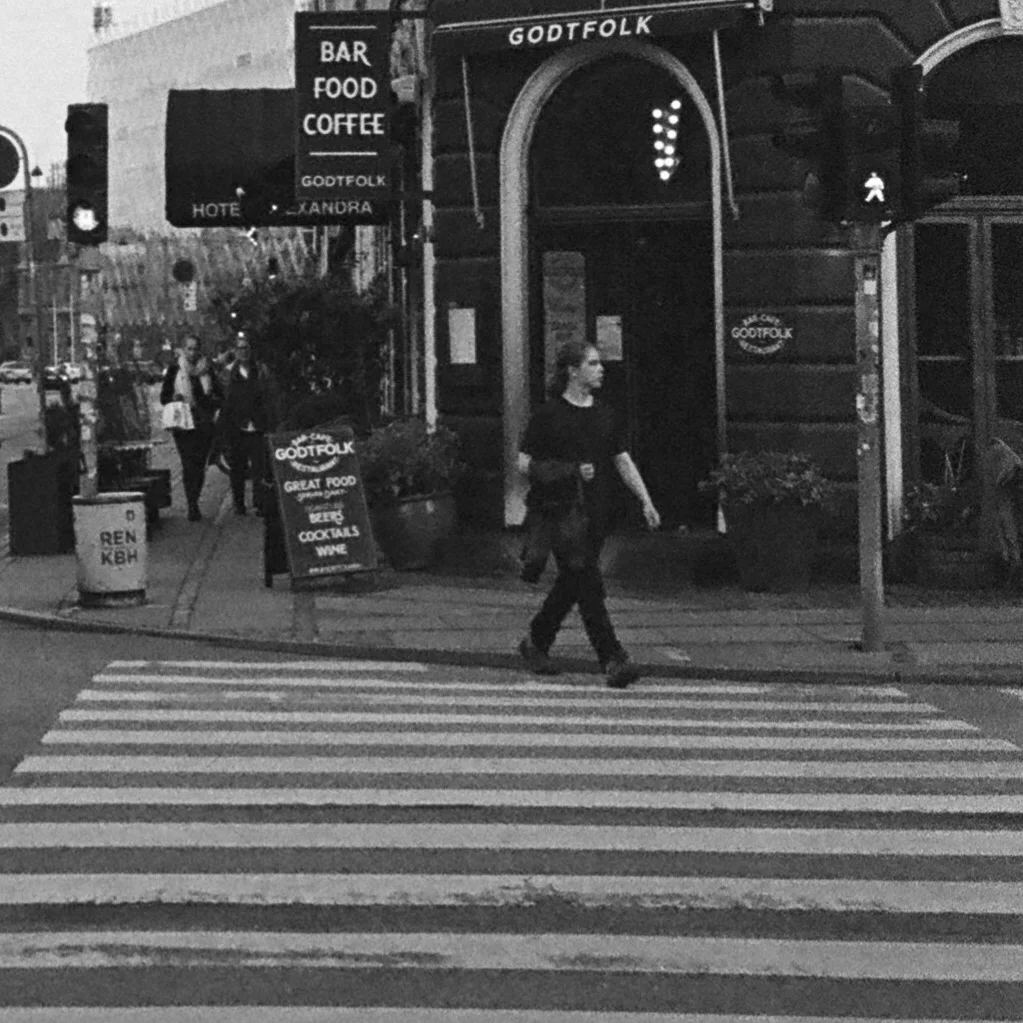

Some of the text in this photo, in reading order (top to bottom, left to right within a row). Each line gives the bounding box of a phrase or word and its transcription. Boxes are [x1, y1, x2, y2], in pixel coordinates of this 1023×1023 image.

[508, 14, 653, 46] GODTFOLK
[320, 40, 372, 67] BAR
[313, 76, 378, 99] FOOD
[302, 113, 385, 136] COFFEE
[300, 175, 387, 188] GODTFOLK
[191, 200, 373, 218] HOTE XANDRA
[730, 326, 794, 339] GODTFOLK
[274, 441, 355, 461] GODTFOLK
[284, 475, 357, 492] GREAT FOOD
[308, 509, 345, 525] BEERS
[99, 530, 137, 546] REN
[298, 525, 360, 543] COCKTAILS
[100, 549, 138, 565] KBH
[316, 543, 348, 557] WINE
